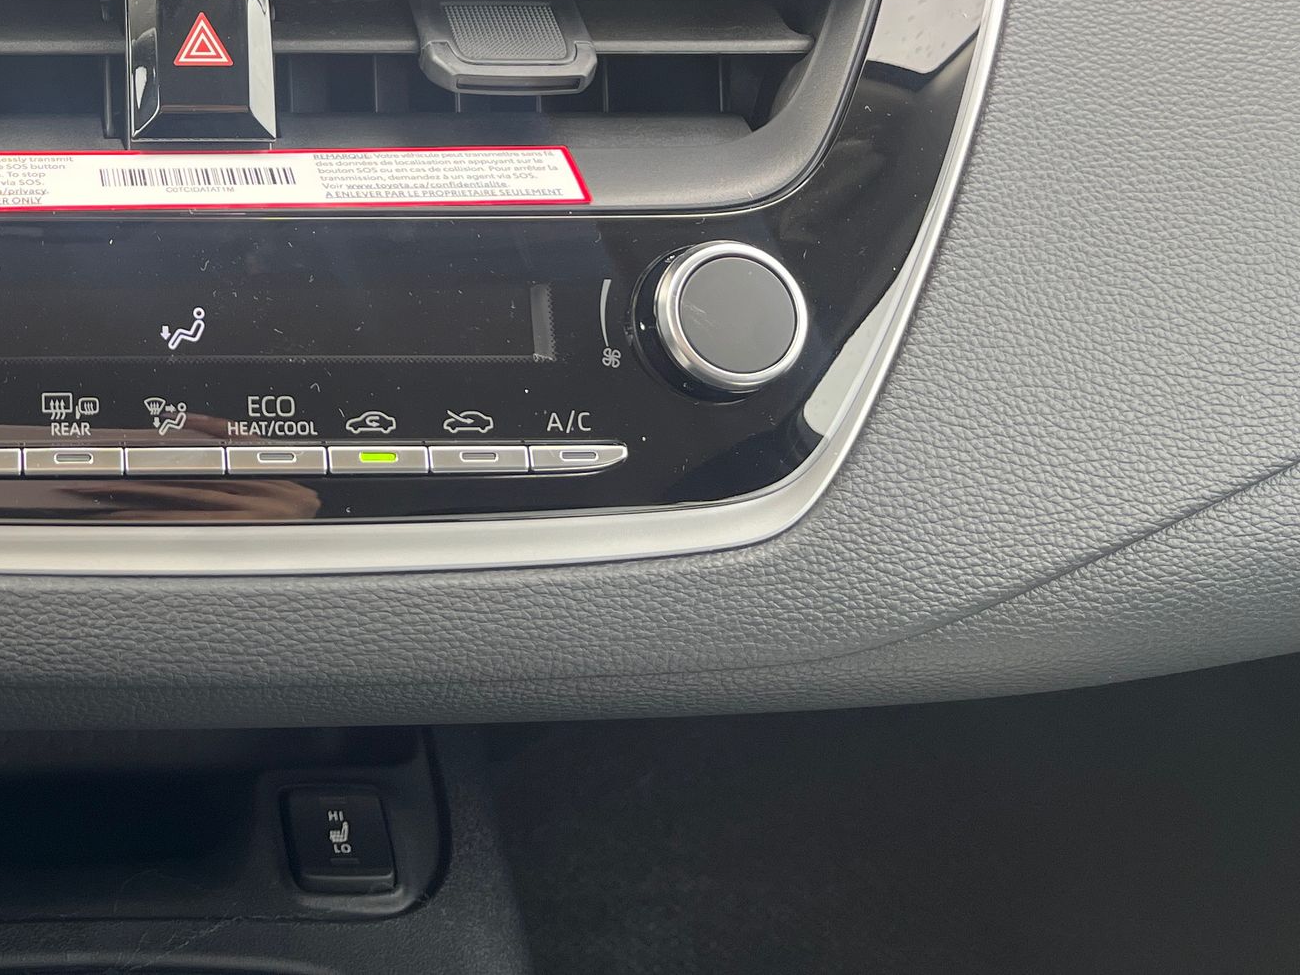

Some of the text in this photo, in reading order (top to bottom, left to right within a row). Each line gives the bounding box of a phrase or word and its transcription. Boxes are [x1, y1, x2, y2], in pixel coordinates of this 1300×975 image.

[21, 171, 46, 180] stop
[335, 191, 383, 199] ENLEVER
[384, 190, 404, 198] PAR
[408, 190, 419, 198] LE
[499, 188, 564, 196] SEULEMENT
[11, 197, 42, 205] ONLY
[247, 395, 295, 417] ECO
[546, 410, 592, 433] A/C
[50, 422, 91, 436] REAR
[228, 421, 318, 436] HEAT/COOL
[327, 810, 344, 822] HI
[333, 843, 352, 854] LO
